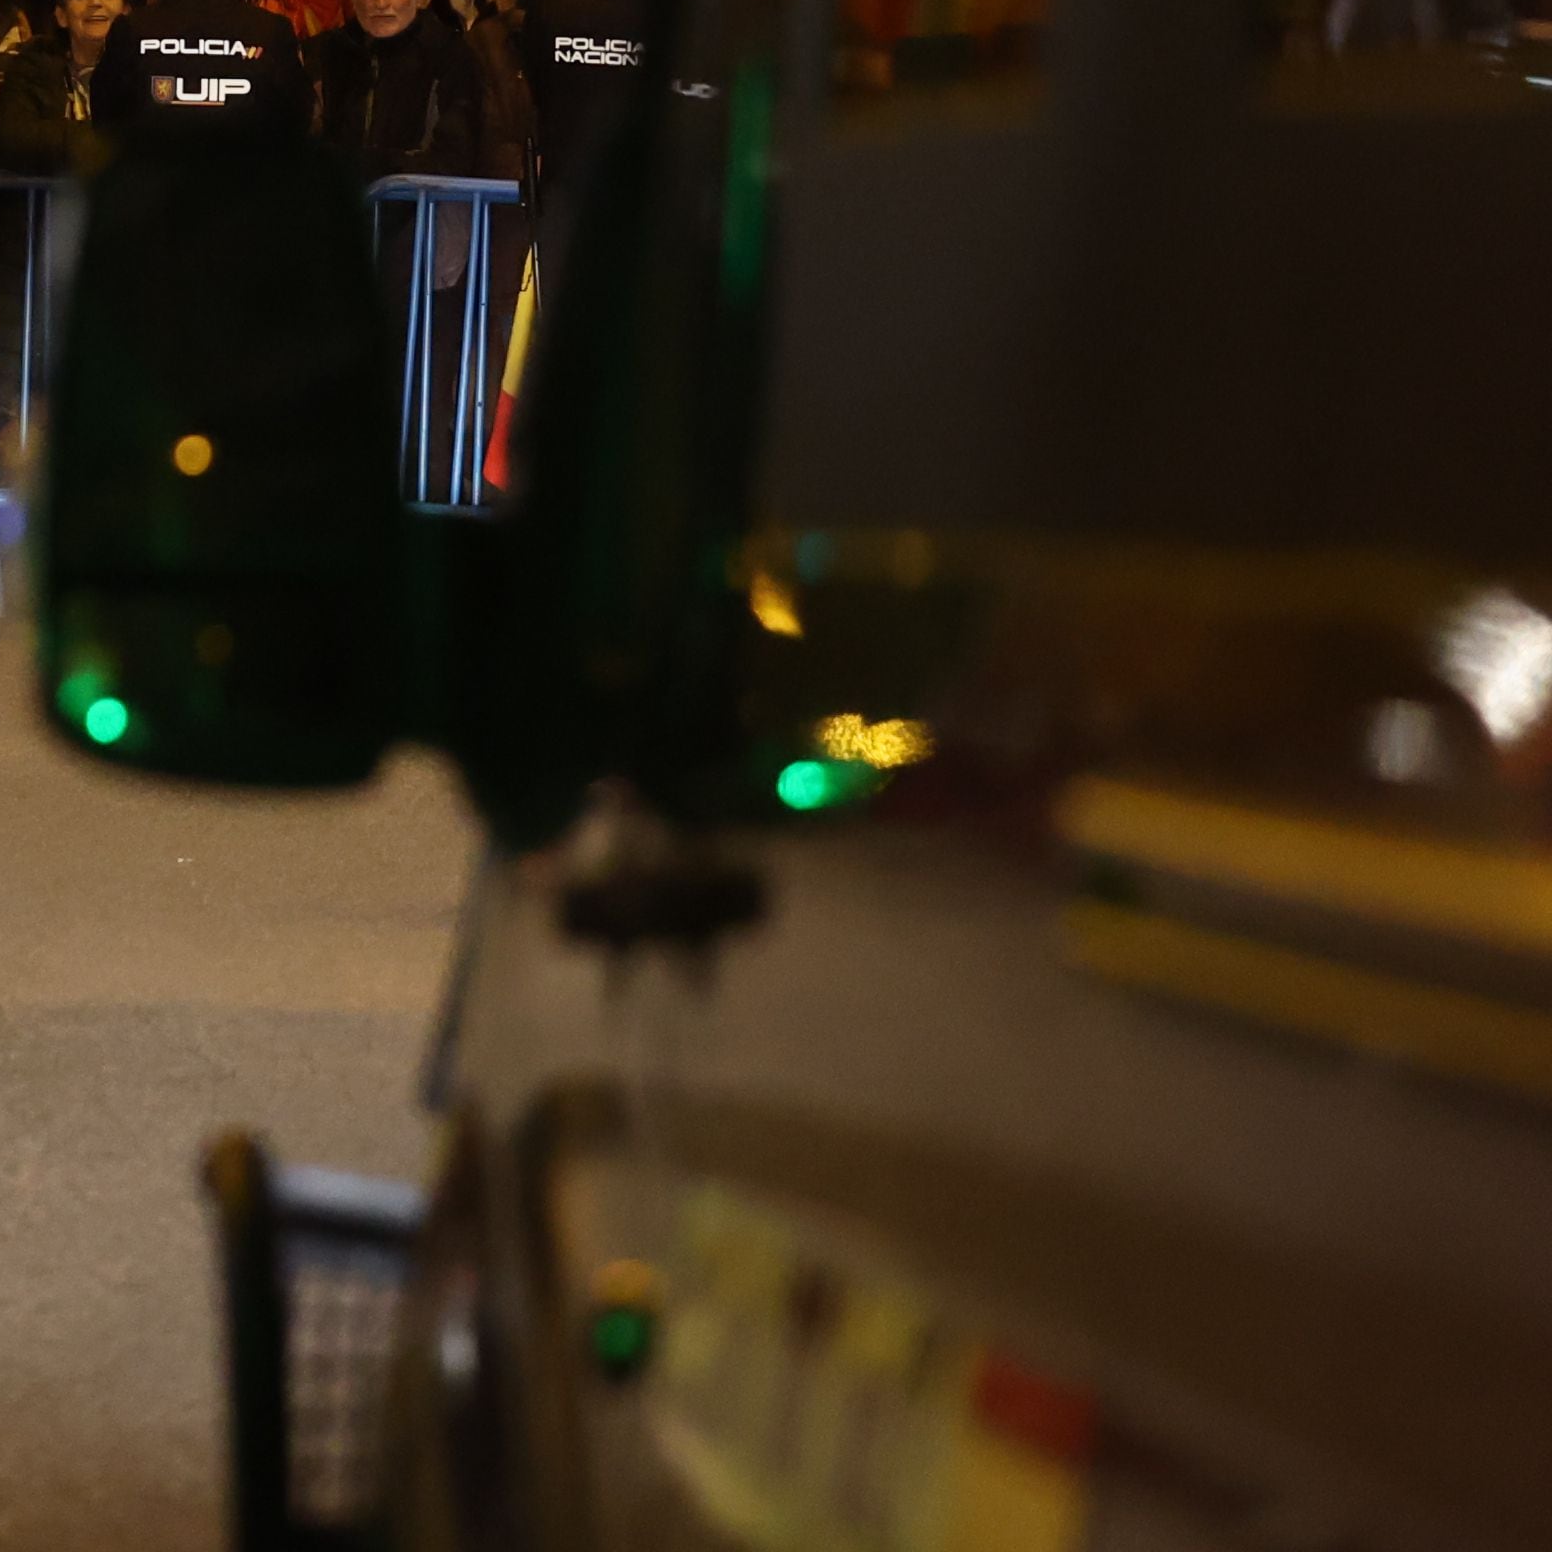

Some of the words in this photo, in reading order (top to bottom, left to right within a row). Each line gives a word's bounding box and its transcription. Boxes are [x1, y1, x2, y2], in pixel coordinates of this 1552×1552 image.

[140, 39, 248, 57] POLICIA
[554, 50, 639, 66] NACION
[176, 77, 252, 102] UIP
